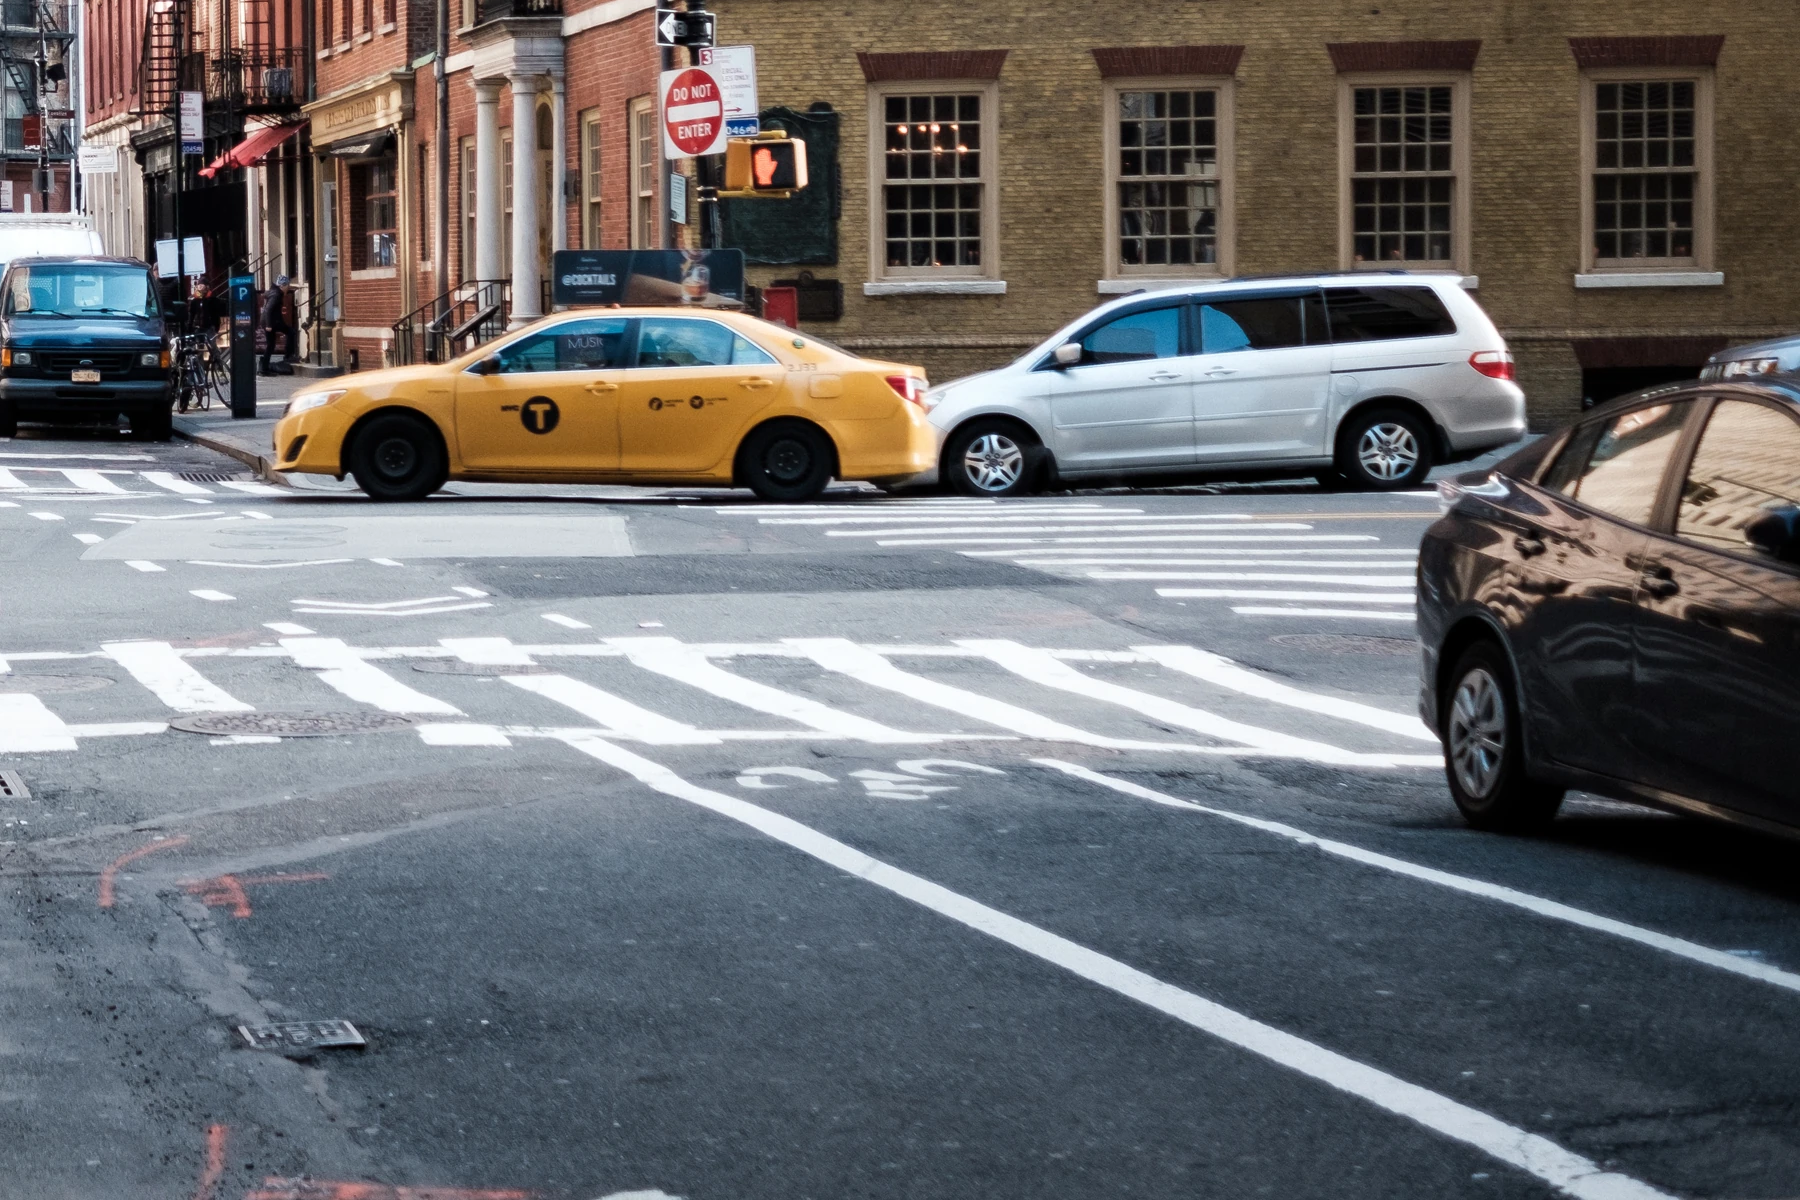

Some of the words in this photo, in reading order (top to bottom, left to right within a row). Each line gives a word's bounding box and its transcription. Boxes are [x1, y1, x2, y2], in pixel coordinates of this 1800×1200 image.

[702, 51, 712, 65] 3
[673, 87, 689, 102] DO
[691, 83, 712, 99] NOT
[677, 123, 713, 141] ENTER
